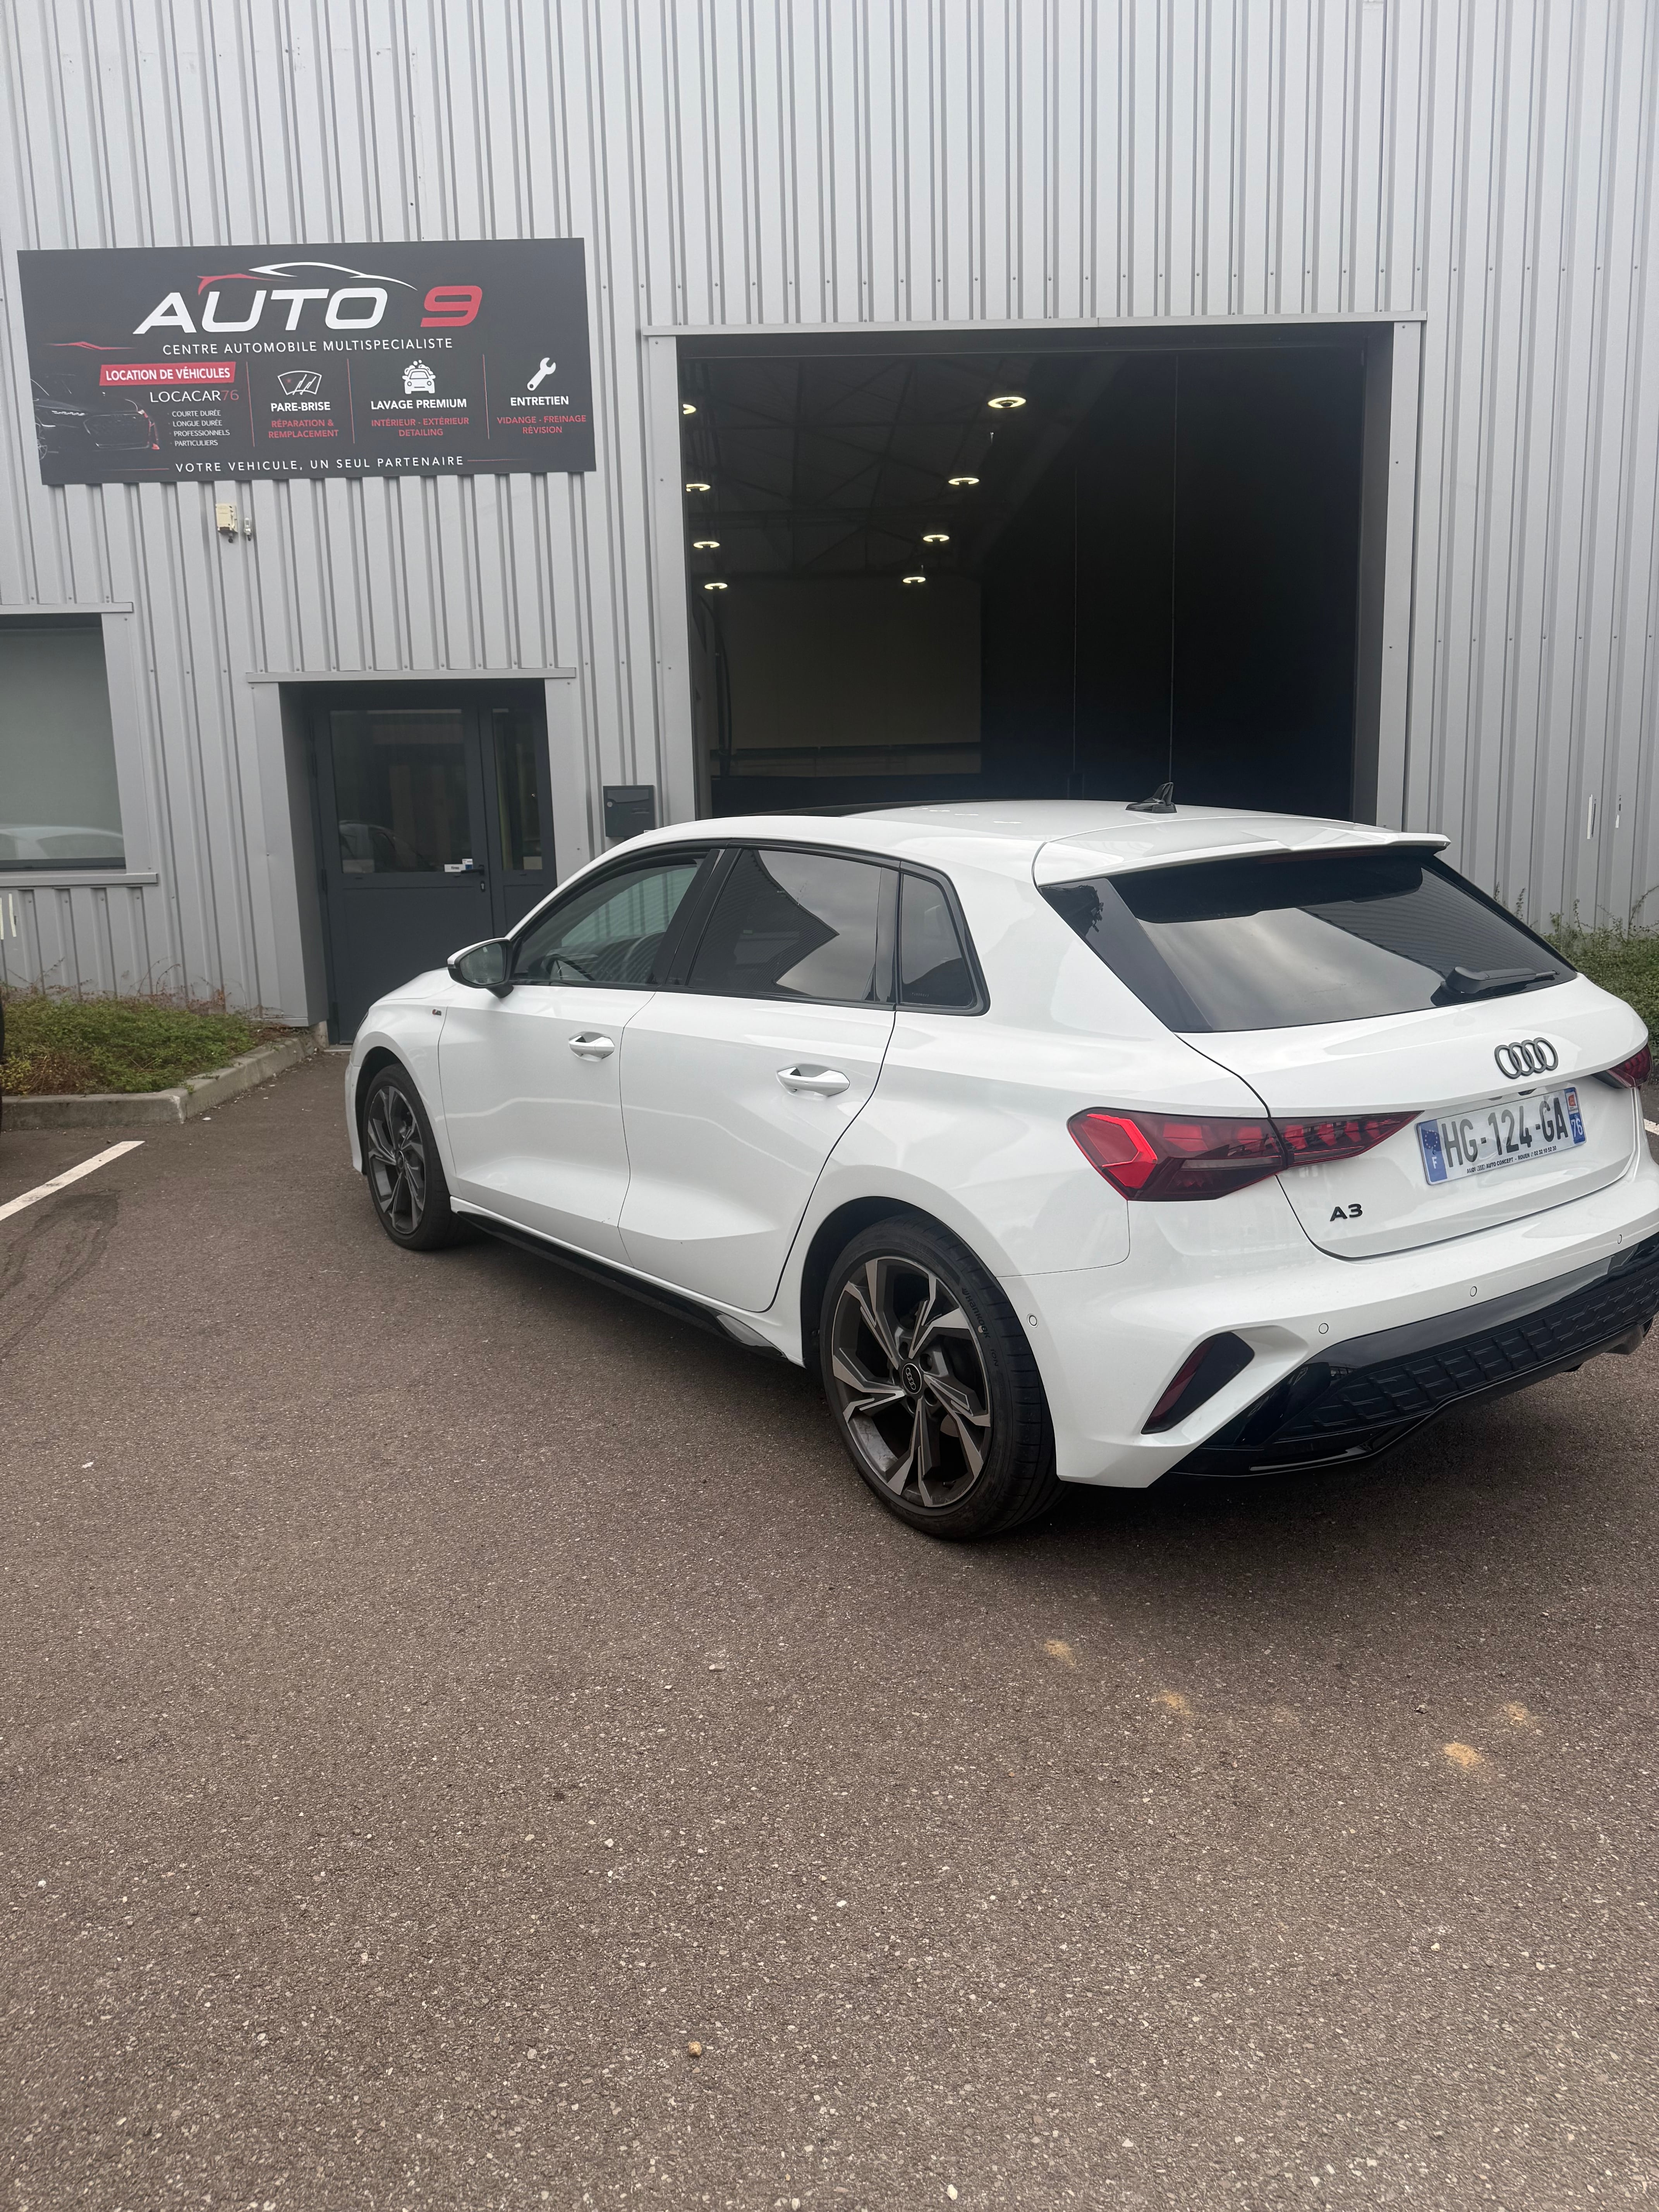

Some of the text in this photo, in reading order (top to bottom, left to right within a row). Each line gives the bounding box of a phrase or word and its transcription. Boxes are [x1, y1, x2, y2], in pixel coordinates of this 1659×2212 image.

[132, 285, 483, 334] AUTO 9
[163, 338, 452, 355] CENTRE AUTOMOBILE MULTISPECIALISTE
[106, 366, 230, 380] LOCATION DE VÉHICULES
[371, 399, 466, 409] LAVAGE PREMIUM
[510, 396, 569, 406] ENTRETIEN
[271, 402, 331, 412] PARE-BRISE
[271, 419, 325, 428] RÉPARATION
[371, 418, 416, 426] INTÉRIEUR
[423, 417, 469, 425] EXTÉRIEUR
[543, 415, 587, 423] FREINAGE
[268, 429, 339, 438] REMPLACEMENT
[522, 426, 562, 434] RÉVISION
[176, 457, 463, 472] VOTRE VEHICULE, UN SEUL PARTENAIRE
[1441, 1097, 1568, 1168] HG-124-GA
[1570, 1118, 1583, 1137] 76
[1432, 1156, 1437, 1169] F
[1497, 1157, 1513, 1166] CONCEPT
[1330, 1204, 1363, 1222] A3
